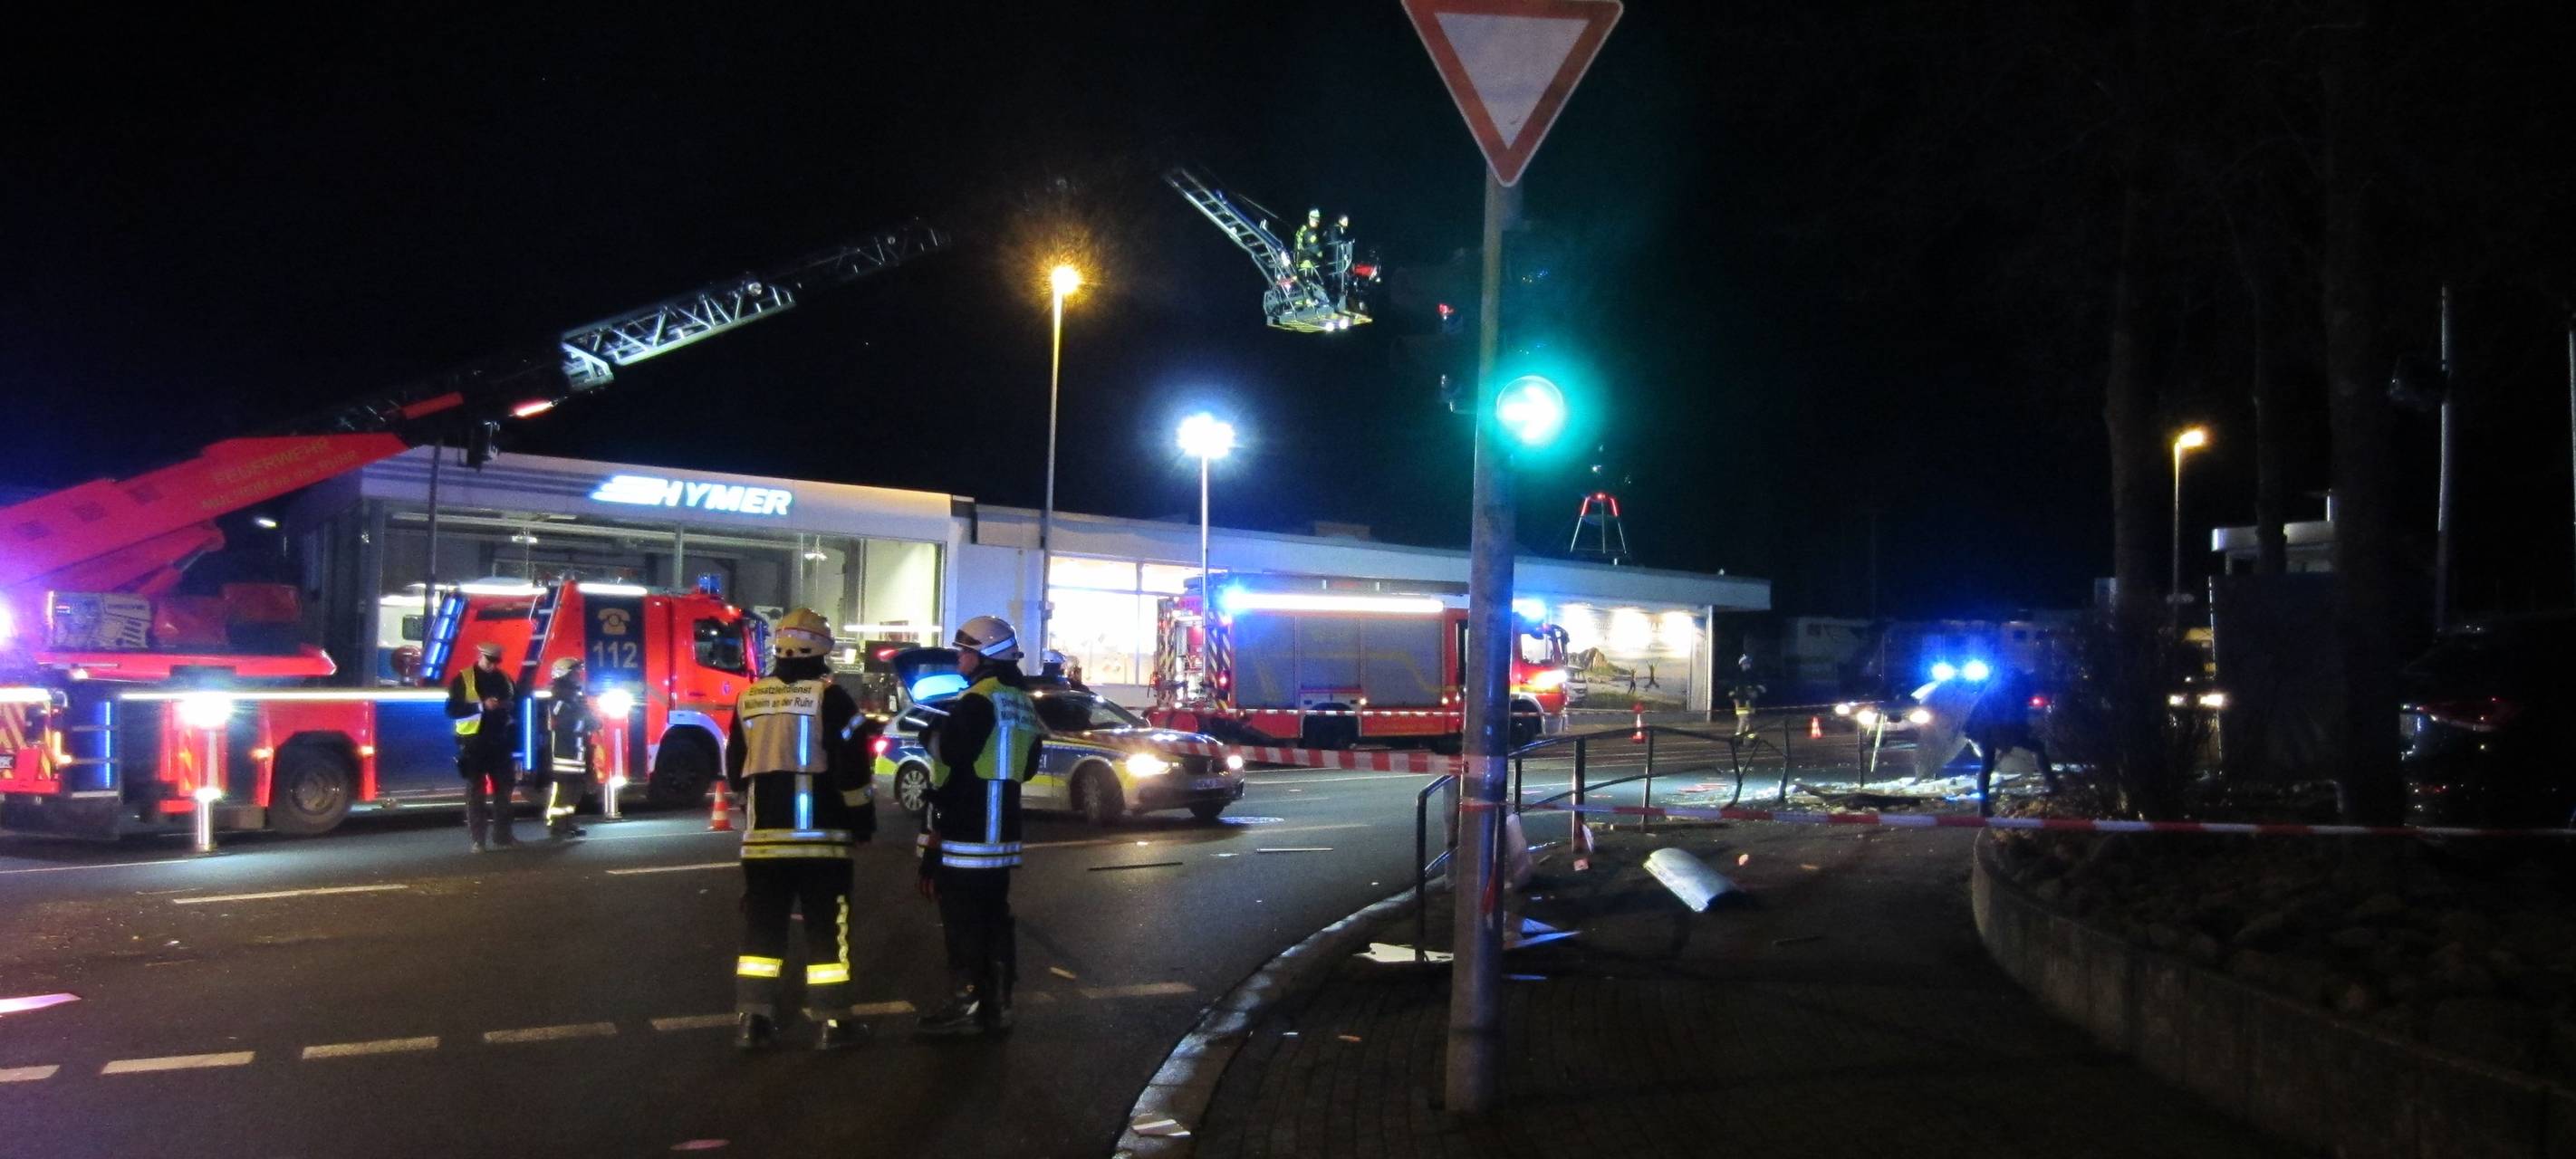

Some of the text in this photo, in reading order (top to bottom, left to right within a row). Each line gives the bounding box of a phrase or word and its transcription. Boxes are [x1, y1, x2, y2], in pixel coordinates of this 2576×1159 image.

[212, 436, 329, 485] FEUERWEHR
[654, 478, 793, 515] HYMER
[592, 640, 638, 668] 112
[794, 697, 813, 707] Ruhr
